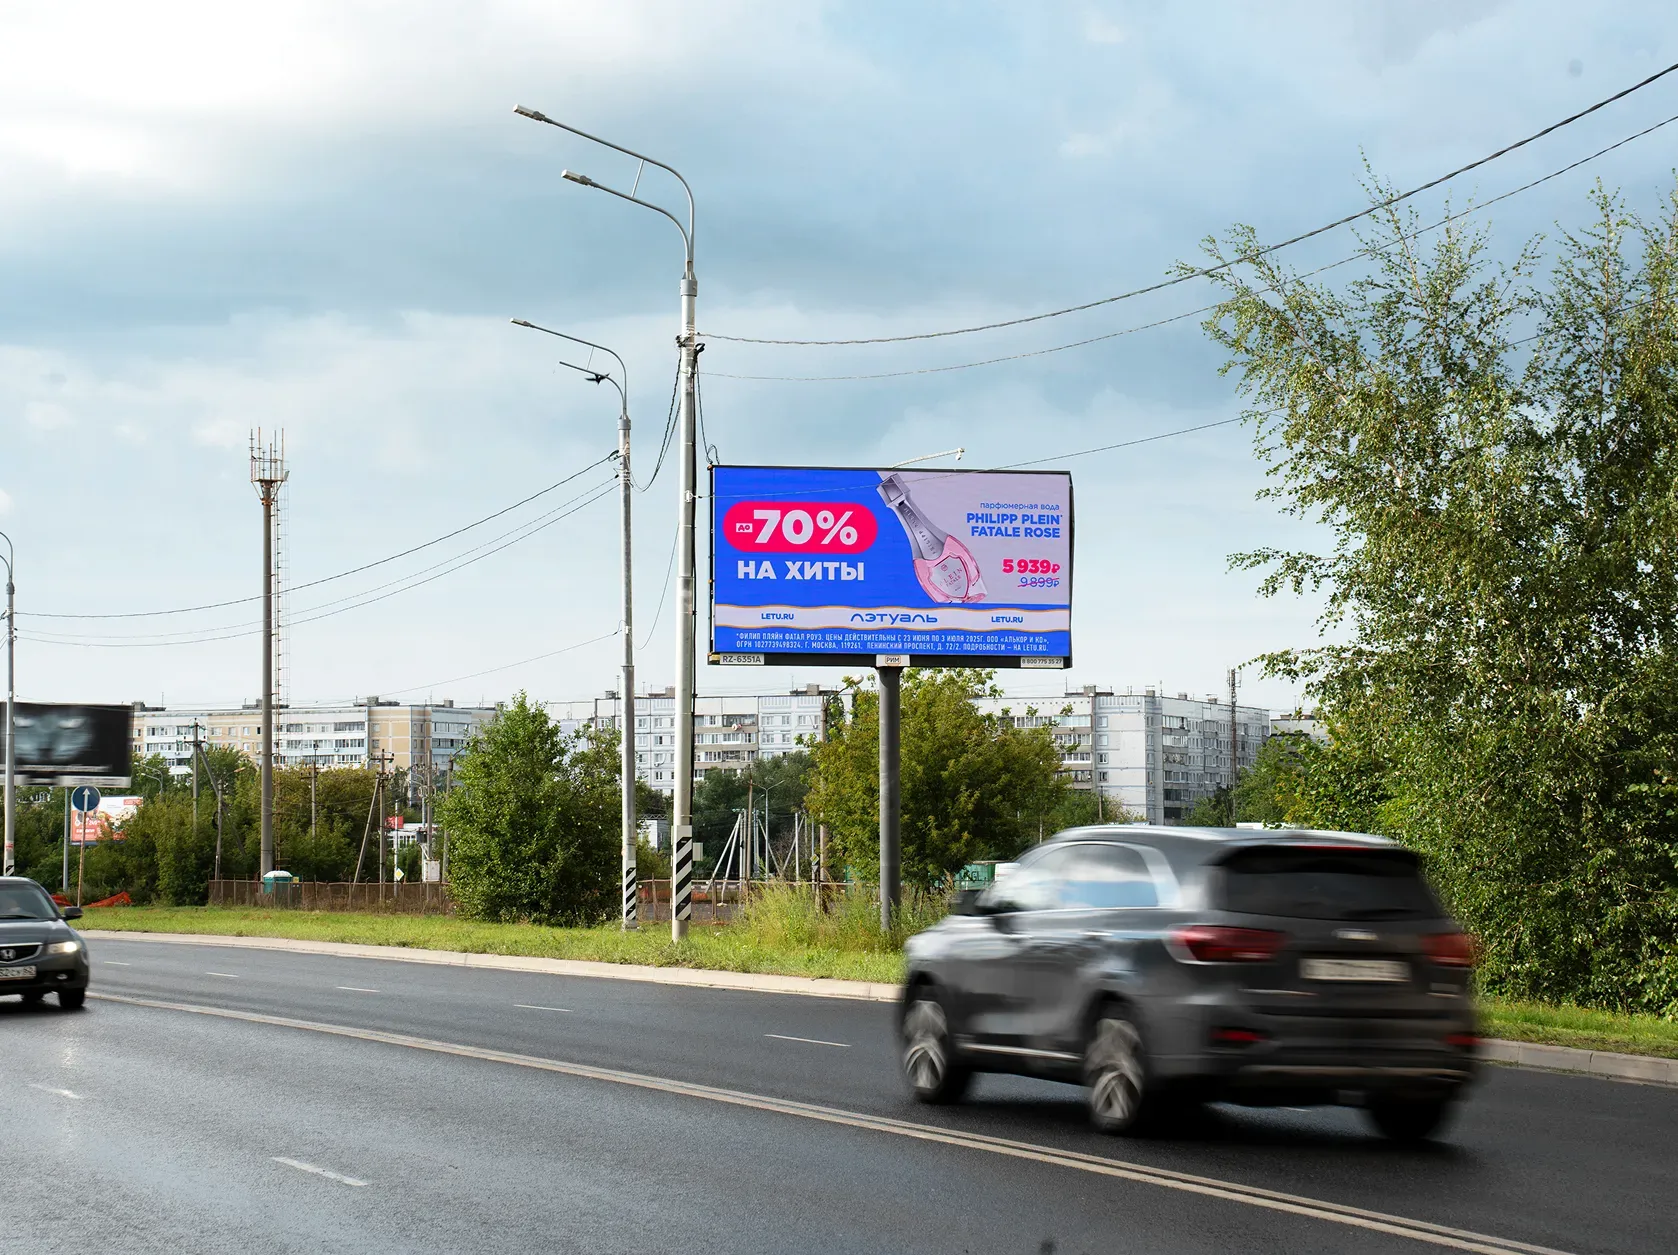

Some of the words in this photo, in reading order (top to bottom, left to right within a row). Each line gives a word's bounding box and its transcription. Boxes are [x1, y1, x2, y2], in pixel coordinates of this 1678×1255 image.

[980, 502, 1039, 510] парфюмерная
[1040, 503, 1060, 511] вода
[966, 513, 1018, 524] PHILIPP
[971, 526, 1021, 537] FATALE
[1024, 527, 1061, 538] ROSE
[737, 560, 777, 580] НА
[784, 561, 865, 581] ХИТЫ
[1002, 559, 1014, 574] 5
[991, 616, 1024, 624] LETU.RU
[762, 631, 783, 640] ПЛЯЙН
[784, 633, 805, 641] ФАТАЛ
[806, 633, 824, 641] РОУЗ.
[825, 633, 843, 642] ЦЕНЫ
[844, 632, 896, 642] ДЕЙСТВИТЕЛЬНЫ
[946, 635, 965, 643] ИЮЛЯ
[966, 635, 985, 643] 2025Г.
[1000, 636, 1028, 644] «АЛЬКОР
[811, 641, 839, 650] МОСКВА,
[840, 642, 863, 650] 119261,
[903, 643, 936, 651] ПРОСПЕКТ,
[936, 643, 944, 652] Д.
[945, 643, 961, 651] 72/2.
[962, 644, 1006, 652] ПОДРОБНОСТИ
[1022, 644, 1049, 652] LETU.RU.
[722, 654, 762, 664] RZ-6351A
[886, 656, 900, 664] РИМ
